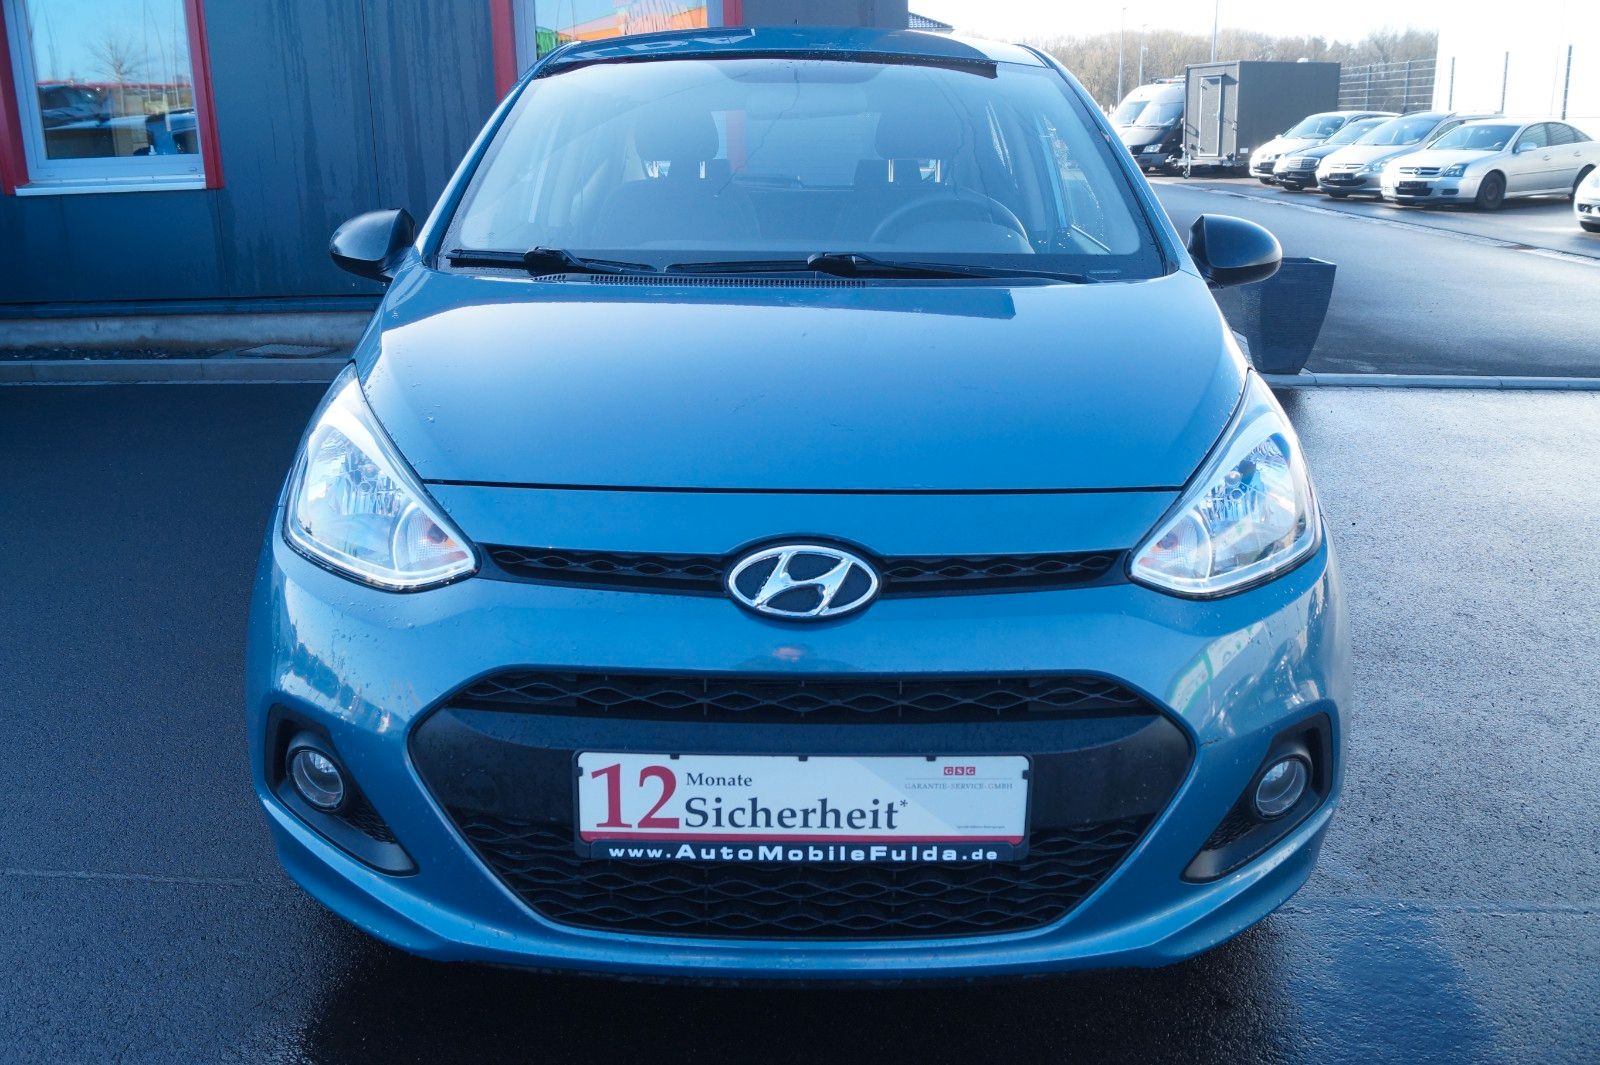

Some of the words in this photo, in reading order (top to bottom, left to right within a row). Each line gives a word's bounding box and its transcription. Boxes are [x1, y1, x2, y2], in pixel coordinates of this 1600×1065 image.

[943, 766, 976, 776] GSG
[686, 772, 753, 787] Monate
[591, 763, 680, 829] 12
[608, 844, 998, 861] www.AutoMobileFulda.de
